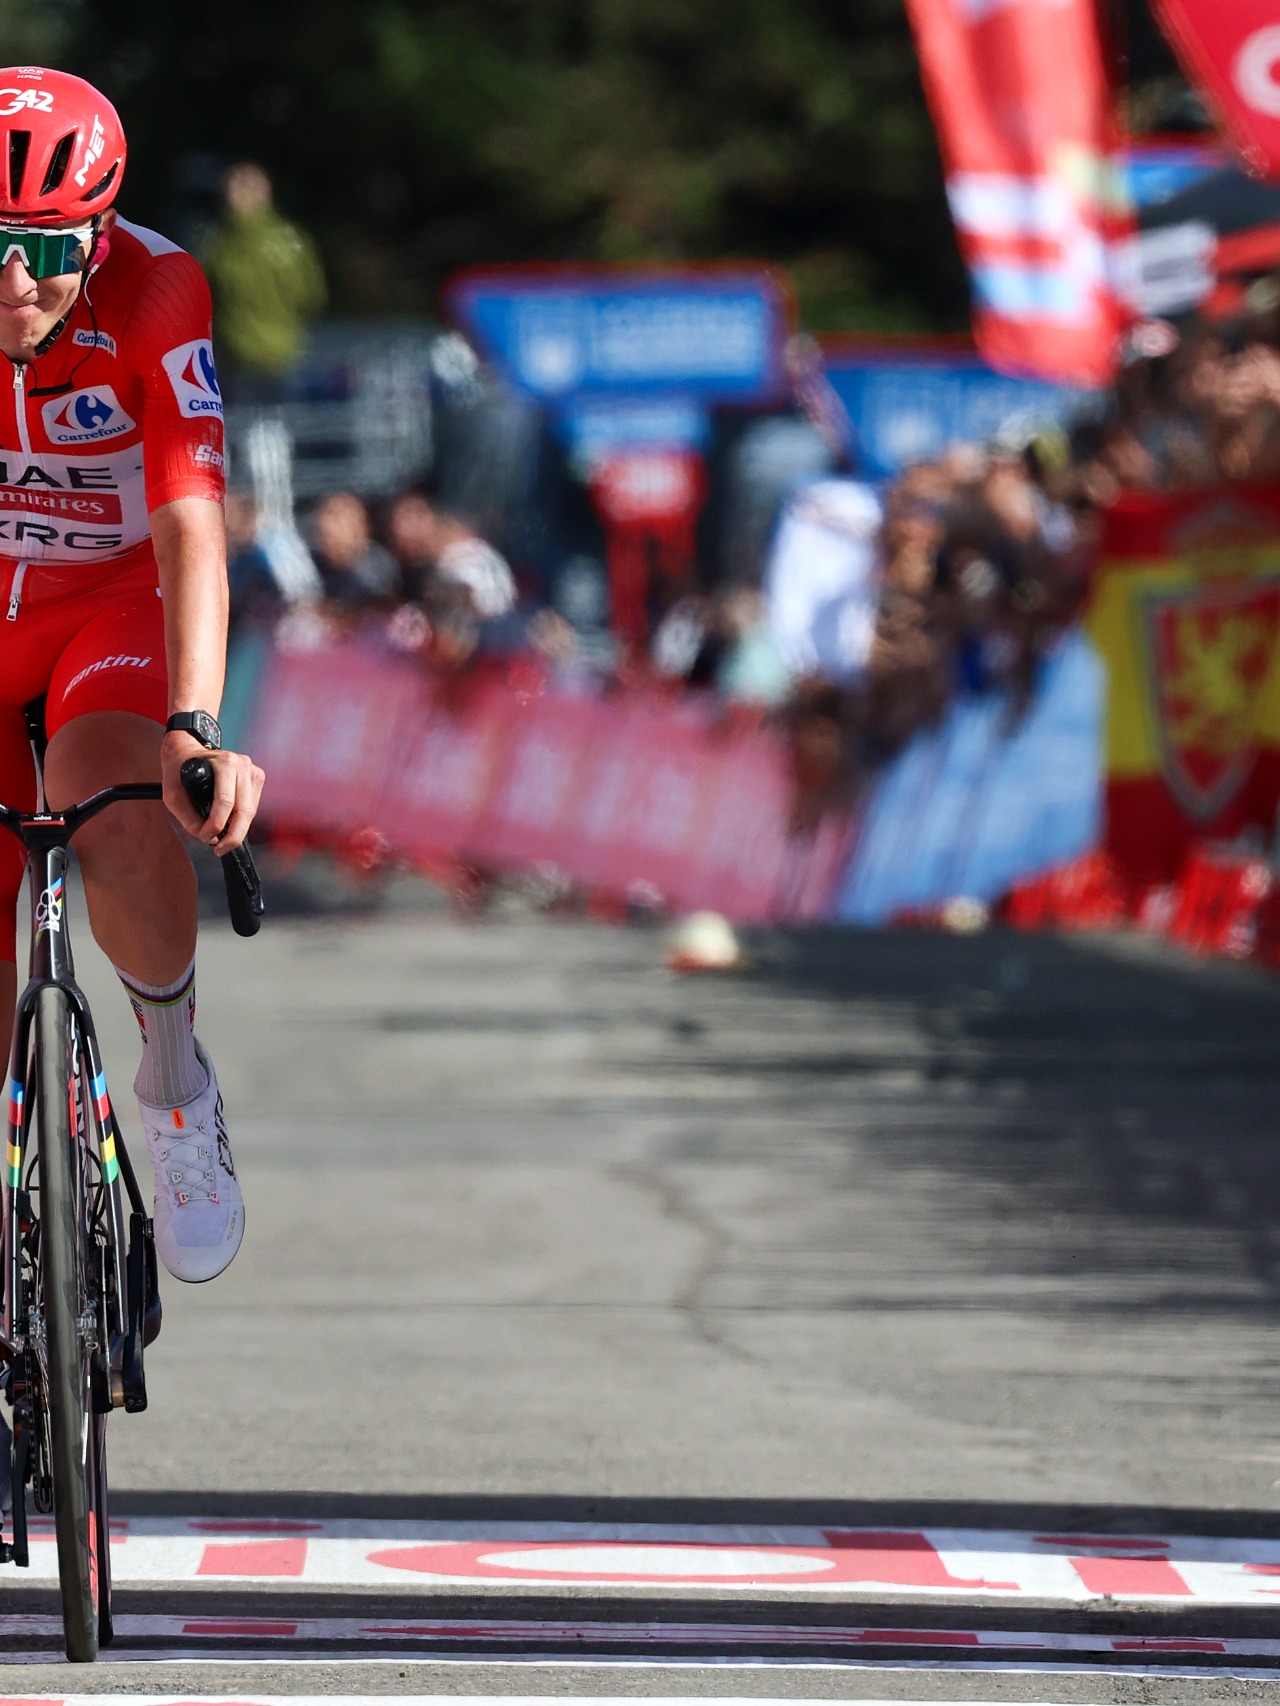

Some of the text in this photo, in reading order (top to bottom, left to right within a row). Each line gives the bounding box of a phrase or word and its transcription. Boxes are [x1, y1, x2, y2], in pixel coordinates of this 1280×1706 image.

[74, 114, 105, 187] MET
[57, 423, 128, 443] Carrefour
[63, 653, 152, 701] Santini
